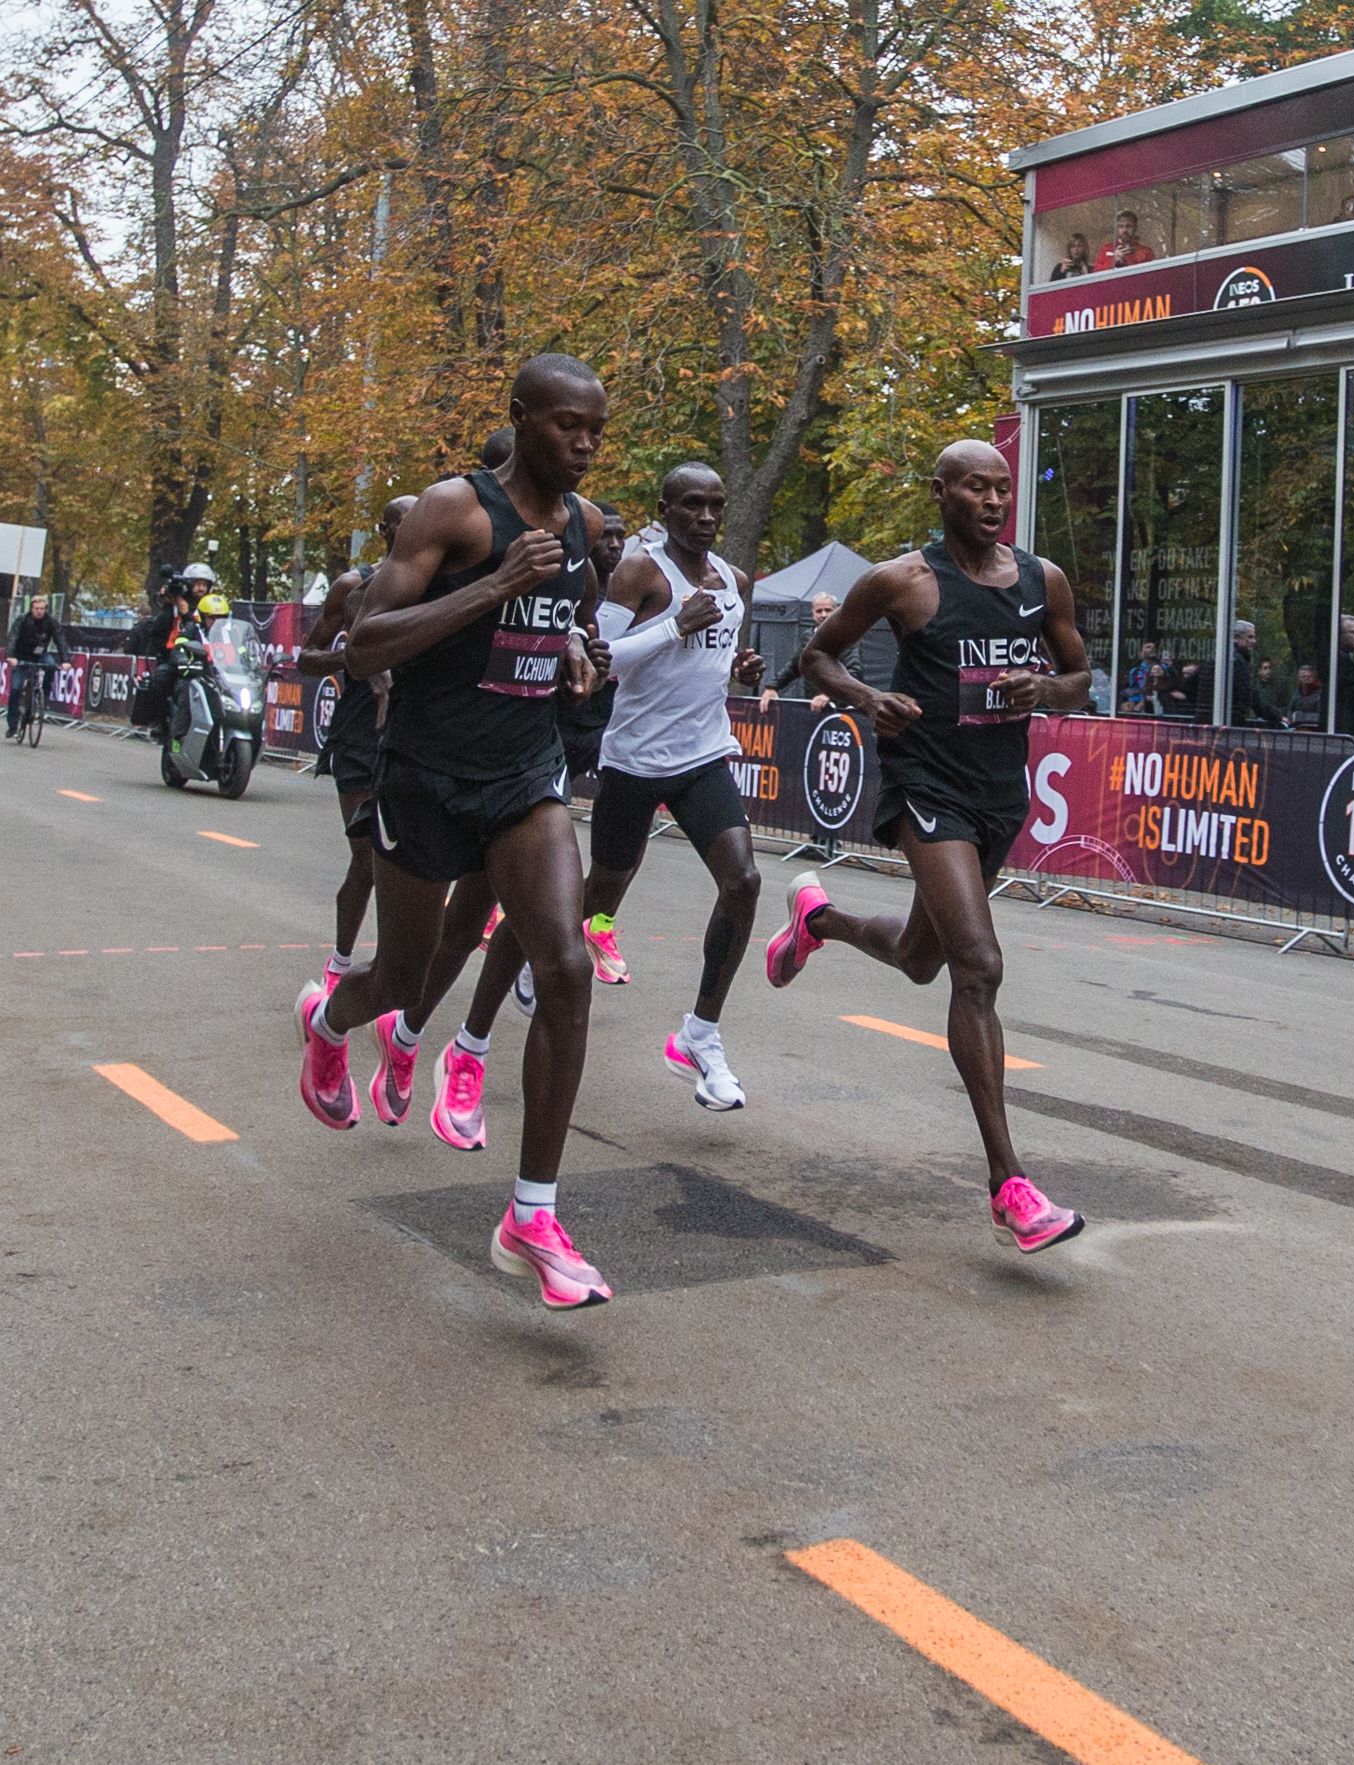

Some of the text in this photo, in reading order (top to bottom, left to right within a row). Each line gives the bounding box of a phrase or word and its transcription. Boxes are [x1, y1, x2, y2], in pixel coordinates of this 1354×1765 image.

[1229, 278, 1260, 297] INEOS
[811, 730, 852, 748] INEOS
[817, 750, 851, 794] 1:59
[1109, 751, 1259, 809] #NOHUMAN
[1138, 804, 1271, 866] ISLIMITED
